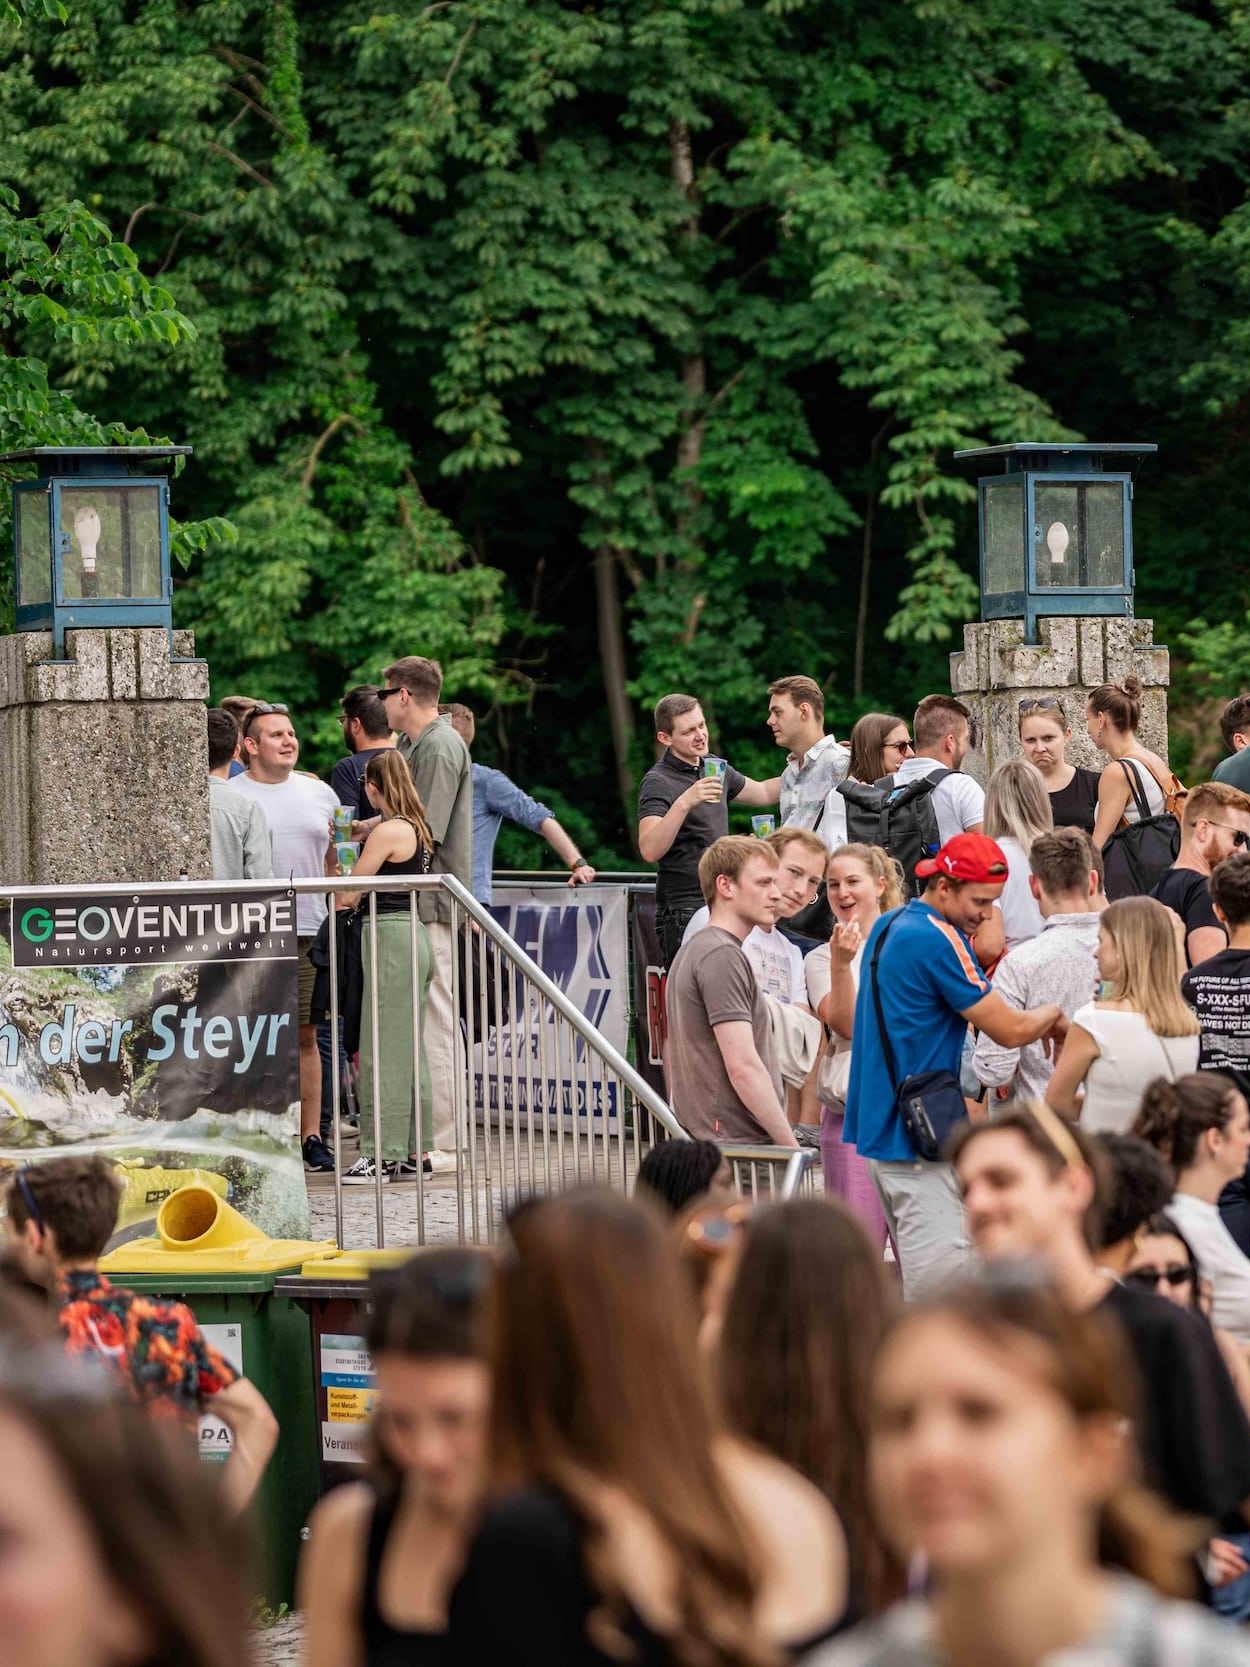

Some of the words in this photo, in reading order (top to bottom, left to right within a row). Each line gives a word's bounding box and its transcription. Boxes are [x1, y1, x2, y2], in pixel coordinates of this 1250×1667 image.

[21, 901, 292, 942] GEOVENTURE
[35, 943, 166, 957] Natursport
[185, 938, 285, 952] weltweit
[40, 1004, 133, 1065] der
[147, 1003, 290, 1074] Steyr
[1224, 1021, 1241, 1030] NOT
